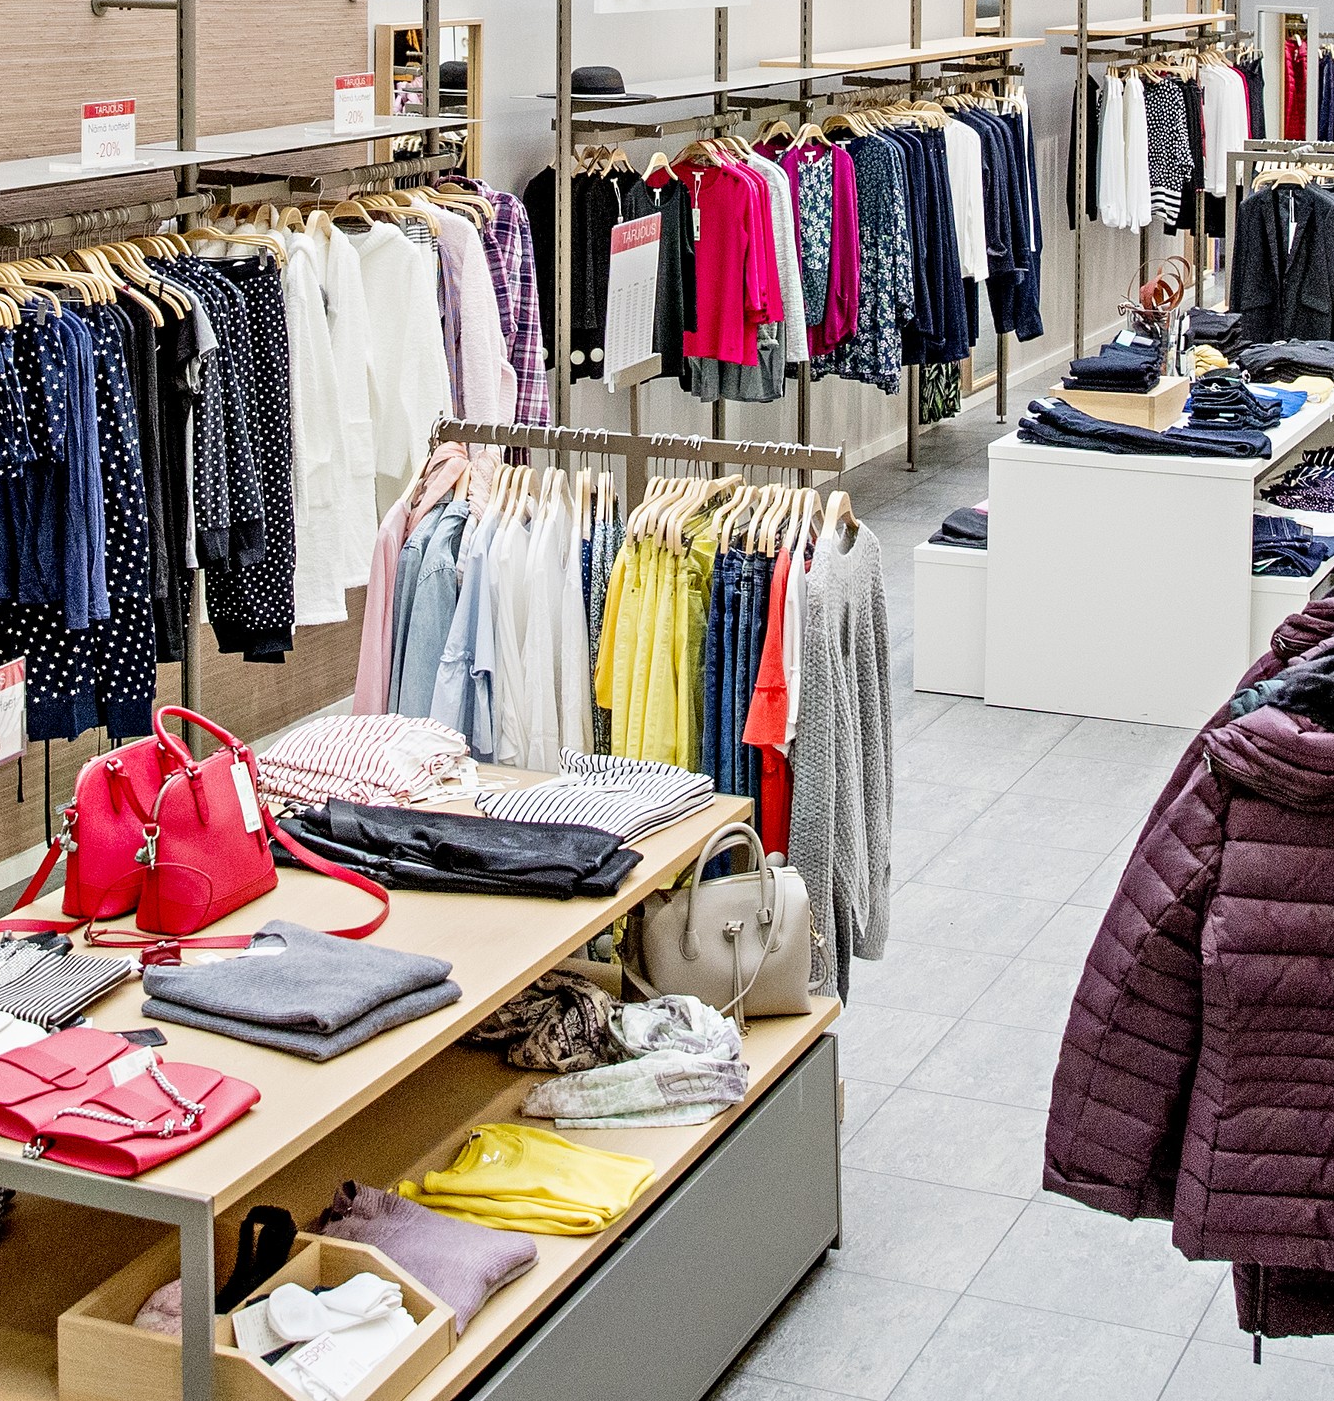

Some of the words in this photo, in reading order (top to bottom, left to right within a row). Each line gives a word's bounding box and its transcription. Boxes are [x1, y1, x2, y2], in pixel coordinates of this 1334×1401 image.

[95, 103, 124, 114] TARJOUS
[96, 141, 121, 158] -20%
[622, 222, 657, 245] TARJOUS
